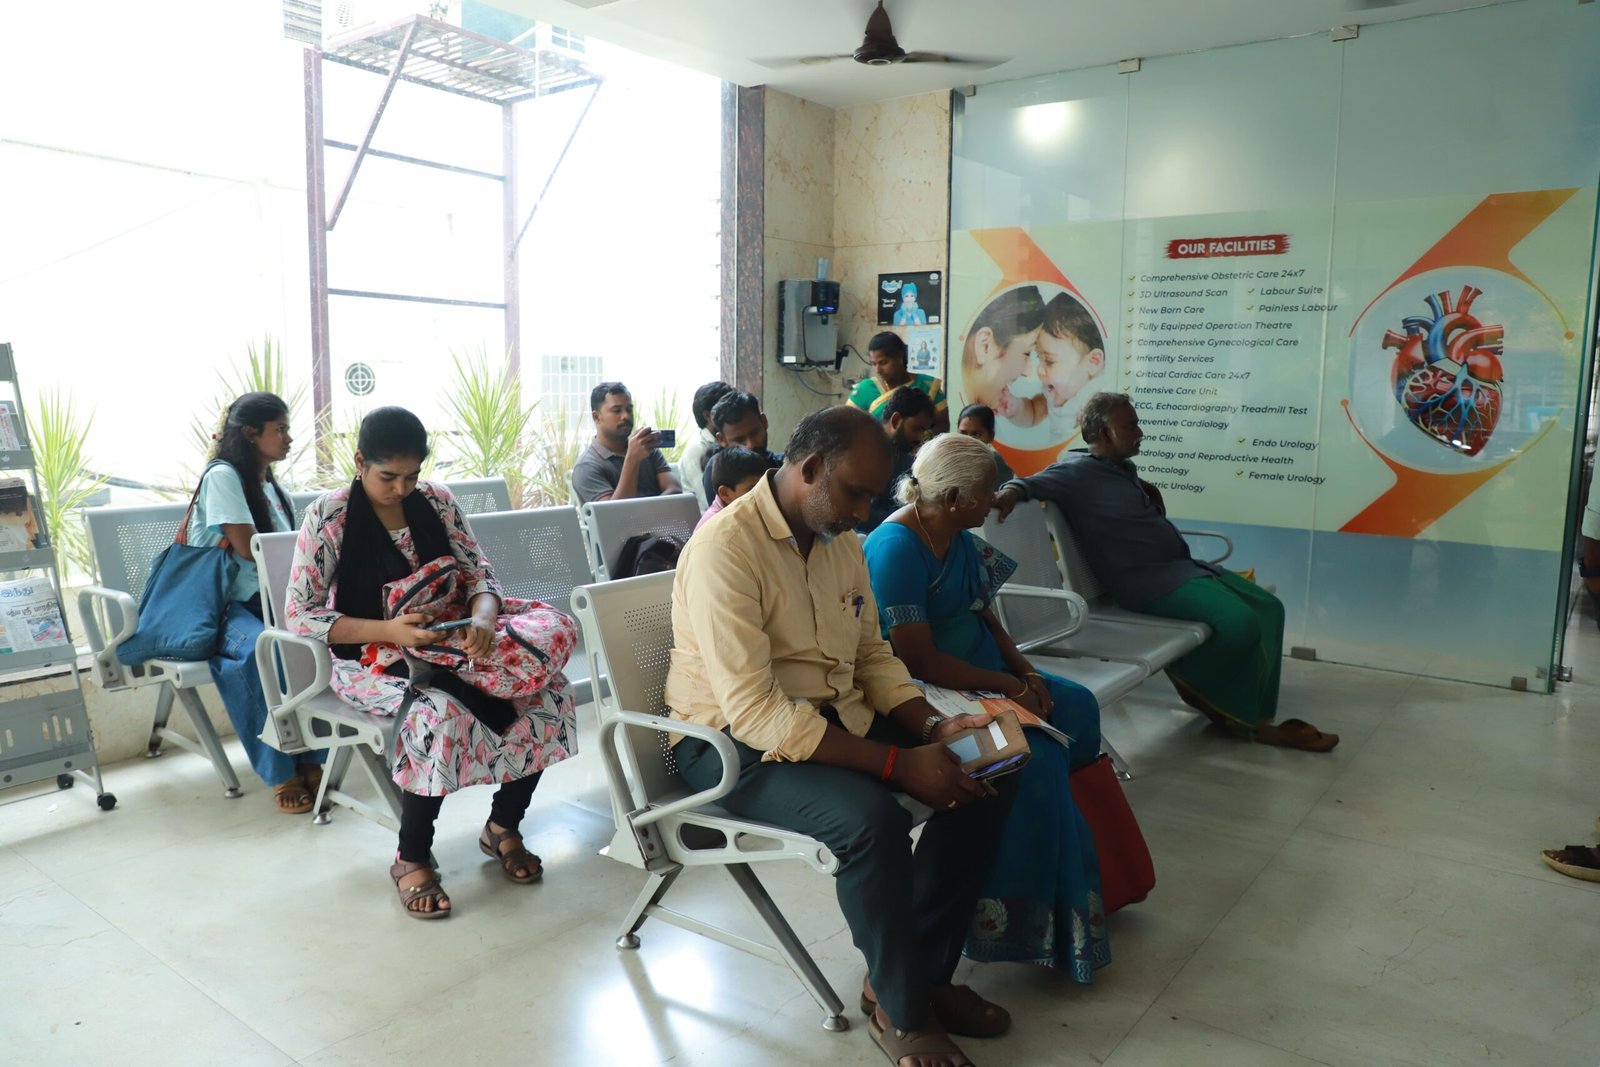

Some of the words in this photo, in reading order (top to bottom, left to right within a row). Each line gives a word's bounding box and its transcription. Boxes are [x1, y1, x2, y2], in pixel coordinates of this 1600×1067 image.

[1178, 243, 1205, 254] OUR
[1209, 240, 1276, 253] FACILITIES
[1140, 273, 1209, 283] Comprehensive
[1211, 270, 1254, 280] Obstetric
[1256, 270, 1279, 279] Care
[1281, 269, 1305, 278] 24x7
[1139, 290, 1152, 299] 3D
[1153, 289, 1203, 298] Ultrasound
[1205, 288, 1229, 297] Scan
[1260, 287, 1295, 296] Labour
[1297, 285, 1323, 295] Suite
[1139, 306, 1159, 315] New
[1160, 306, 1182, 314] Born
[1183, 306, 1205, 314] Care
[1258, 304, 1299, 313] Painless
[1301, 304, 1338, 312] Labour
[1138, 322, 1159, 332] Fully
[1160, 322, 1203, 332] Equipped
[1205, 321, 1252, 331] Operation
[1255, 321, 1293, 330] Theatre
[1137, 339, 1206, 348] Comprehensive
[1207, 338, 1274, 348] Gynecological
[1275, 338, 1299, 347] Care
[1136, 354, 1176, 364] Infertility
[1177, 354, 1215, 363] Services
[1135, 370, 1167, 379] Critical
[1168, 370, 1203, 379] Cardiac
[1204, 371, 1226, 379] Care
[1228, 371, 1251, 380] 24x7
[1134, 386, 1174, 395] Intensive
[1175, 387, 1197, 395] Care
[1199, 387, 1219, 396] Unit
[1134, 401, 1154, 411] ECG,
[1156, 402, 1238, 414] Echocardiography
[1241, 405, 1286, 414] Treadmill
[1288, 406, 1308, 415] Test
[1180, 419, 1230, 430] Cardiology
[1159, 434, 1184, 443] Clinic
[1252, 438, 1278, 447] Endo
[1279, 440, 1319, 451] Urology
[1139, 449, 1176, 460] ndrology
[1177, 451, 1196, 460] and
[1197, 452, 1259, 463] Reproductive
[1260, 455, 1294, 465] Health
[1147, 464, 1190, 476] Oncology
[1248, 471, 1285, 481] Female
[1286, 473, 1326, 485] Urology
[1170, 482, 1205, 493] Urology
